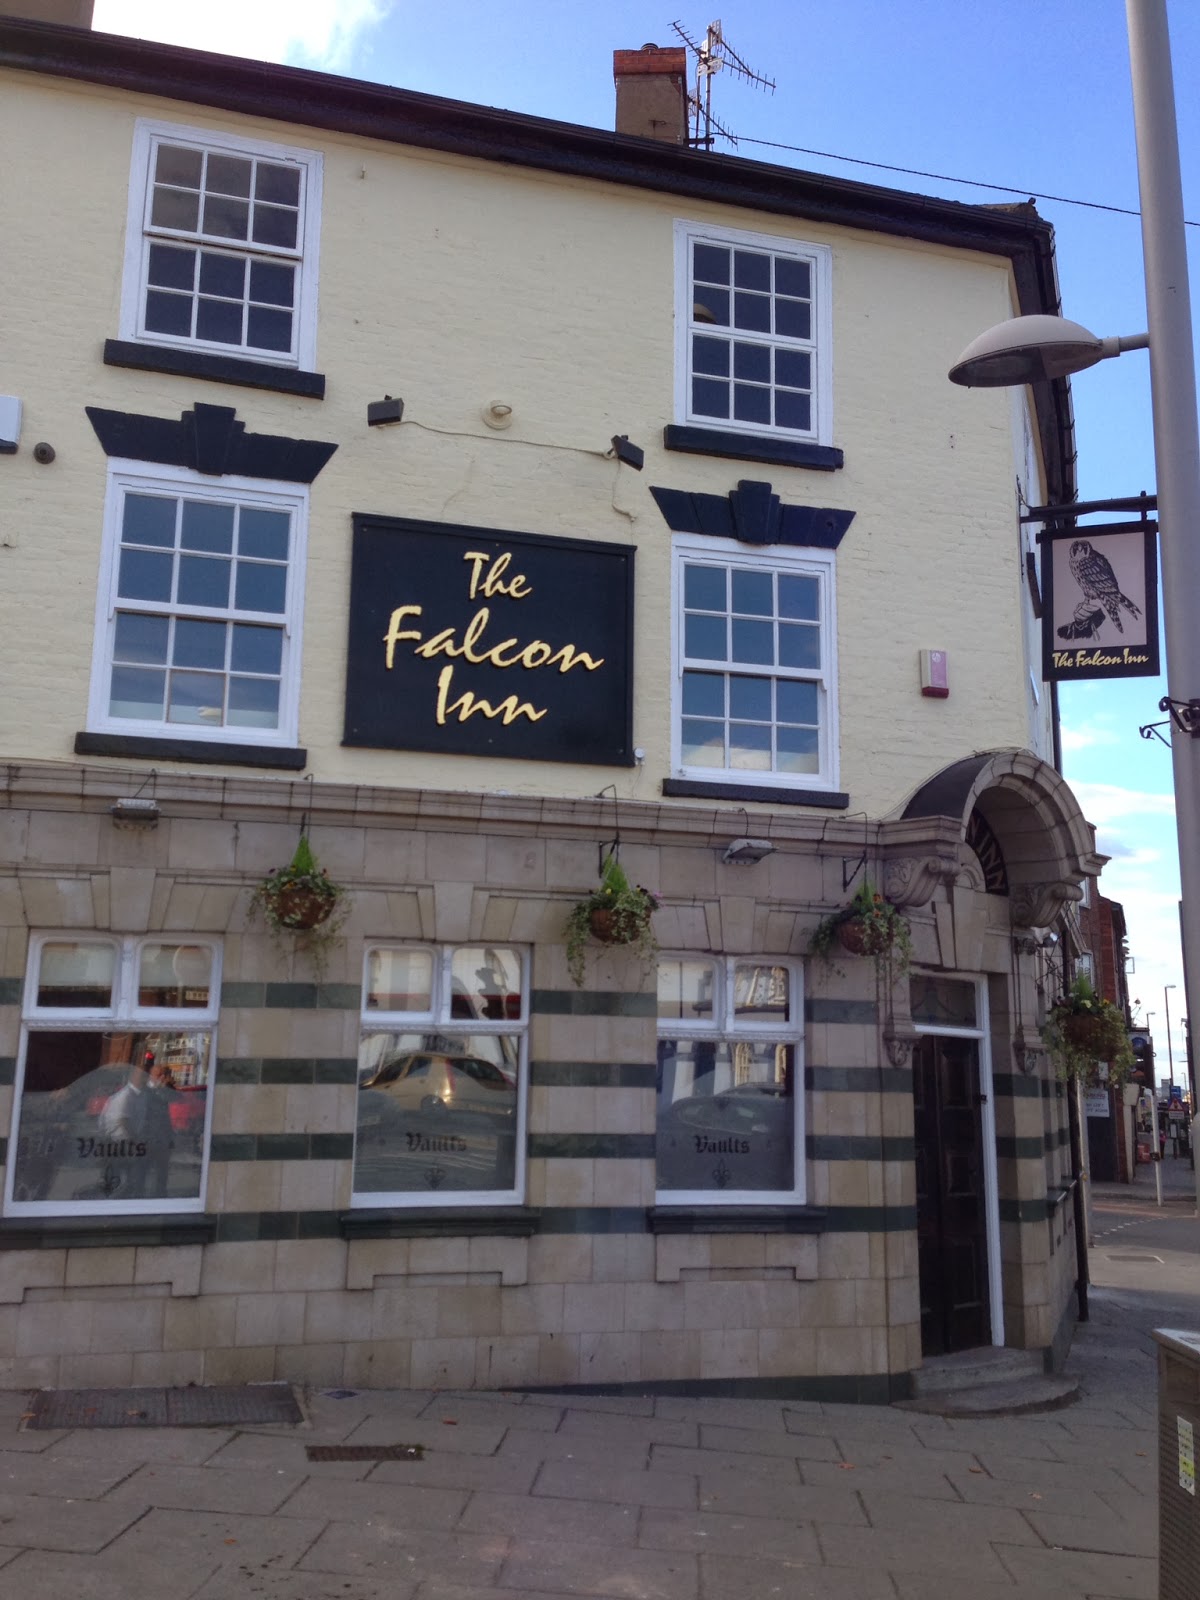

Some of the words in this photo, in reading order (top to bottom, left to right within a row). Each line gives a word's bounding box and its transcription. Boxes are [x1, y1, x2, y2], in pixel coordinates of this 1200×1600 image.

[463, 551, 532, 599] The
[382, 605, 604, 672] Falcon
[1052, 652, 1073, 668] The
[1075, 650, 1121, 667] Falcon
[1123, 648, 1148, 664] Inn
[436, 664, 548, 725] Inn
[76, 1137, 147, 1158] Vaults
[405, 1132, 467, 1152] Vaults
[693, 1134, 750, 1153] Vaults
